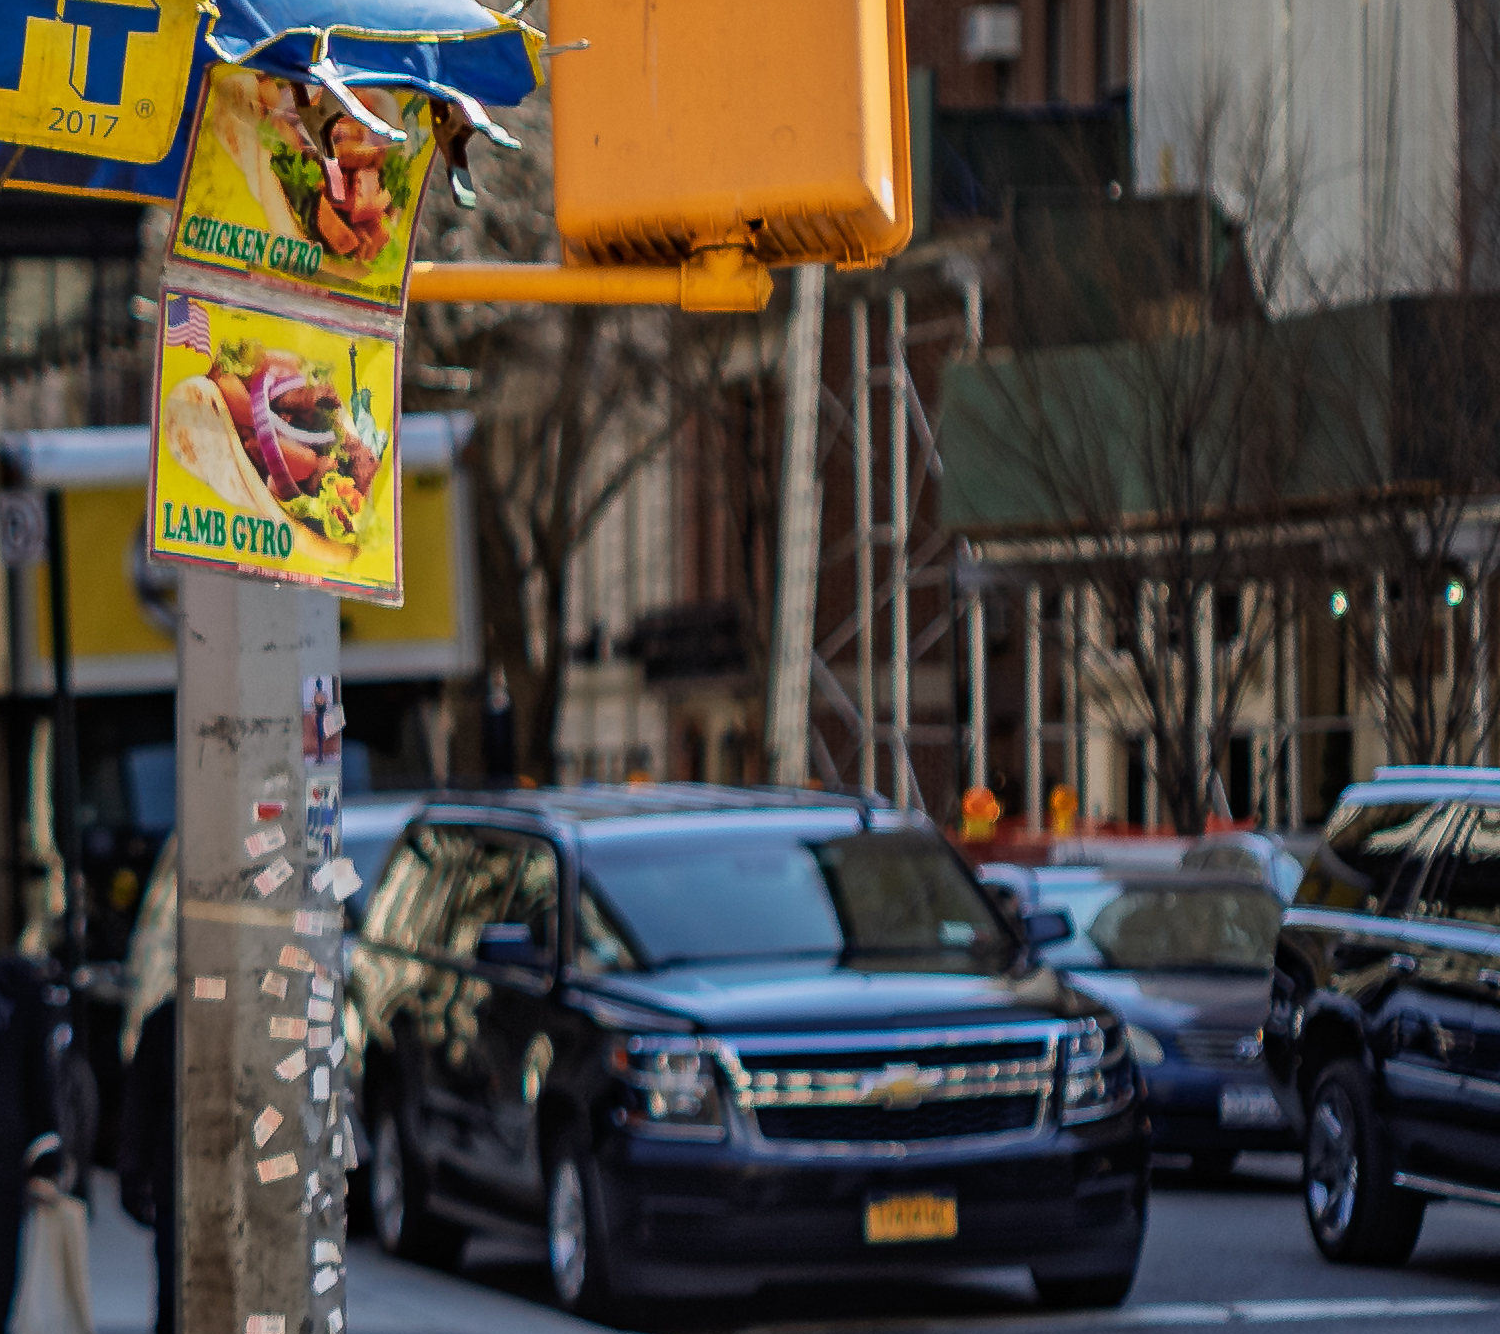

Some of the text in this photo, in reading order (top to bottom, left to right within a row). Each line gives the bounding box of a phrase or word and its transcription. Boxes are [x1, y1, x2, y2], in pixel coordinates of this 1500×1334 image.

[47, 105, 120, 140] 2017
[183, 215, 323, 276] CHICKEN GYRO
[163, 501, 293, 560] LAMB GYRO
